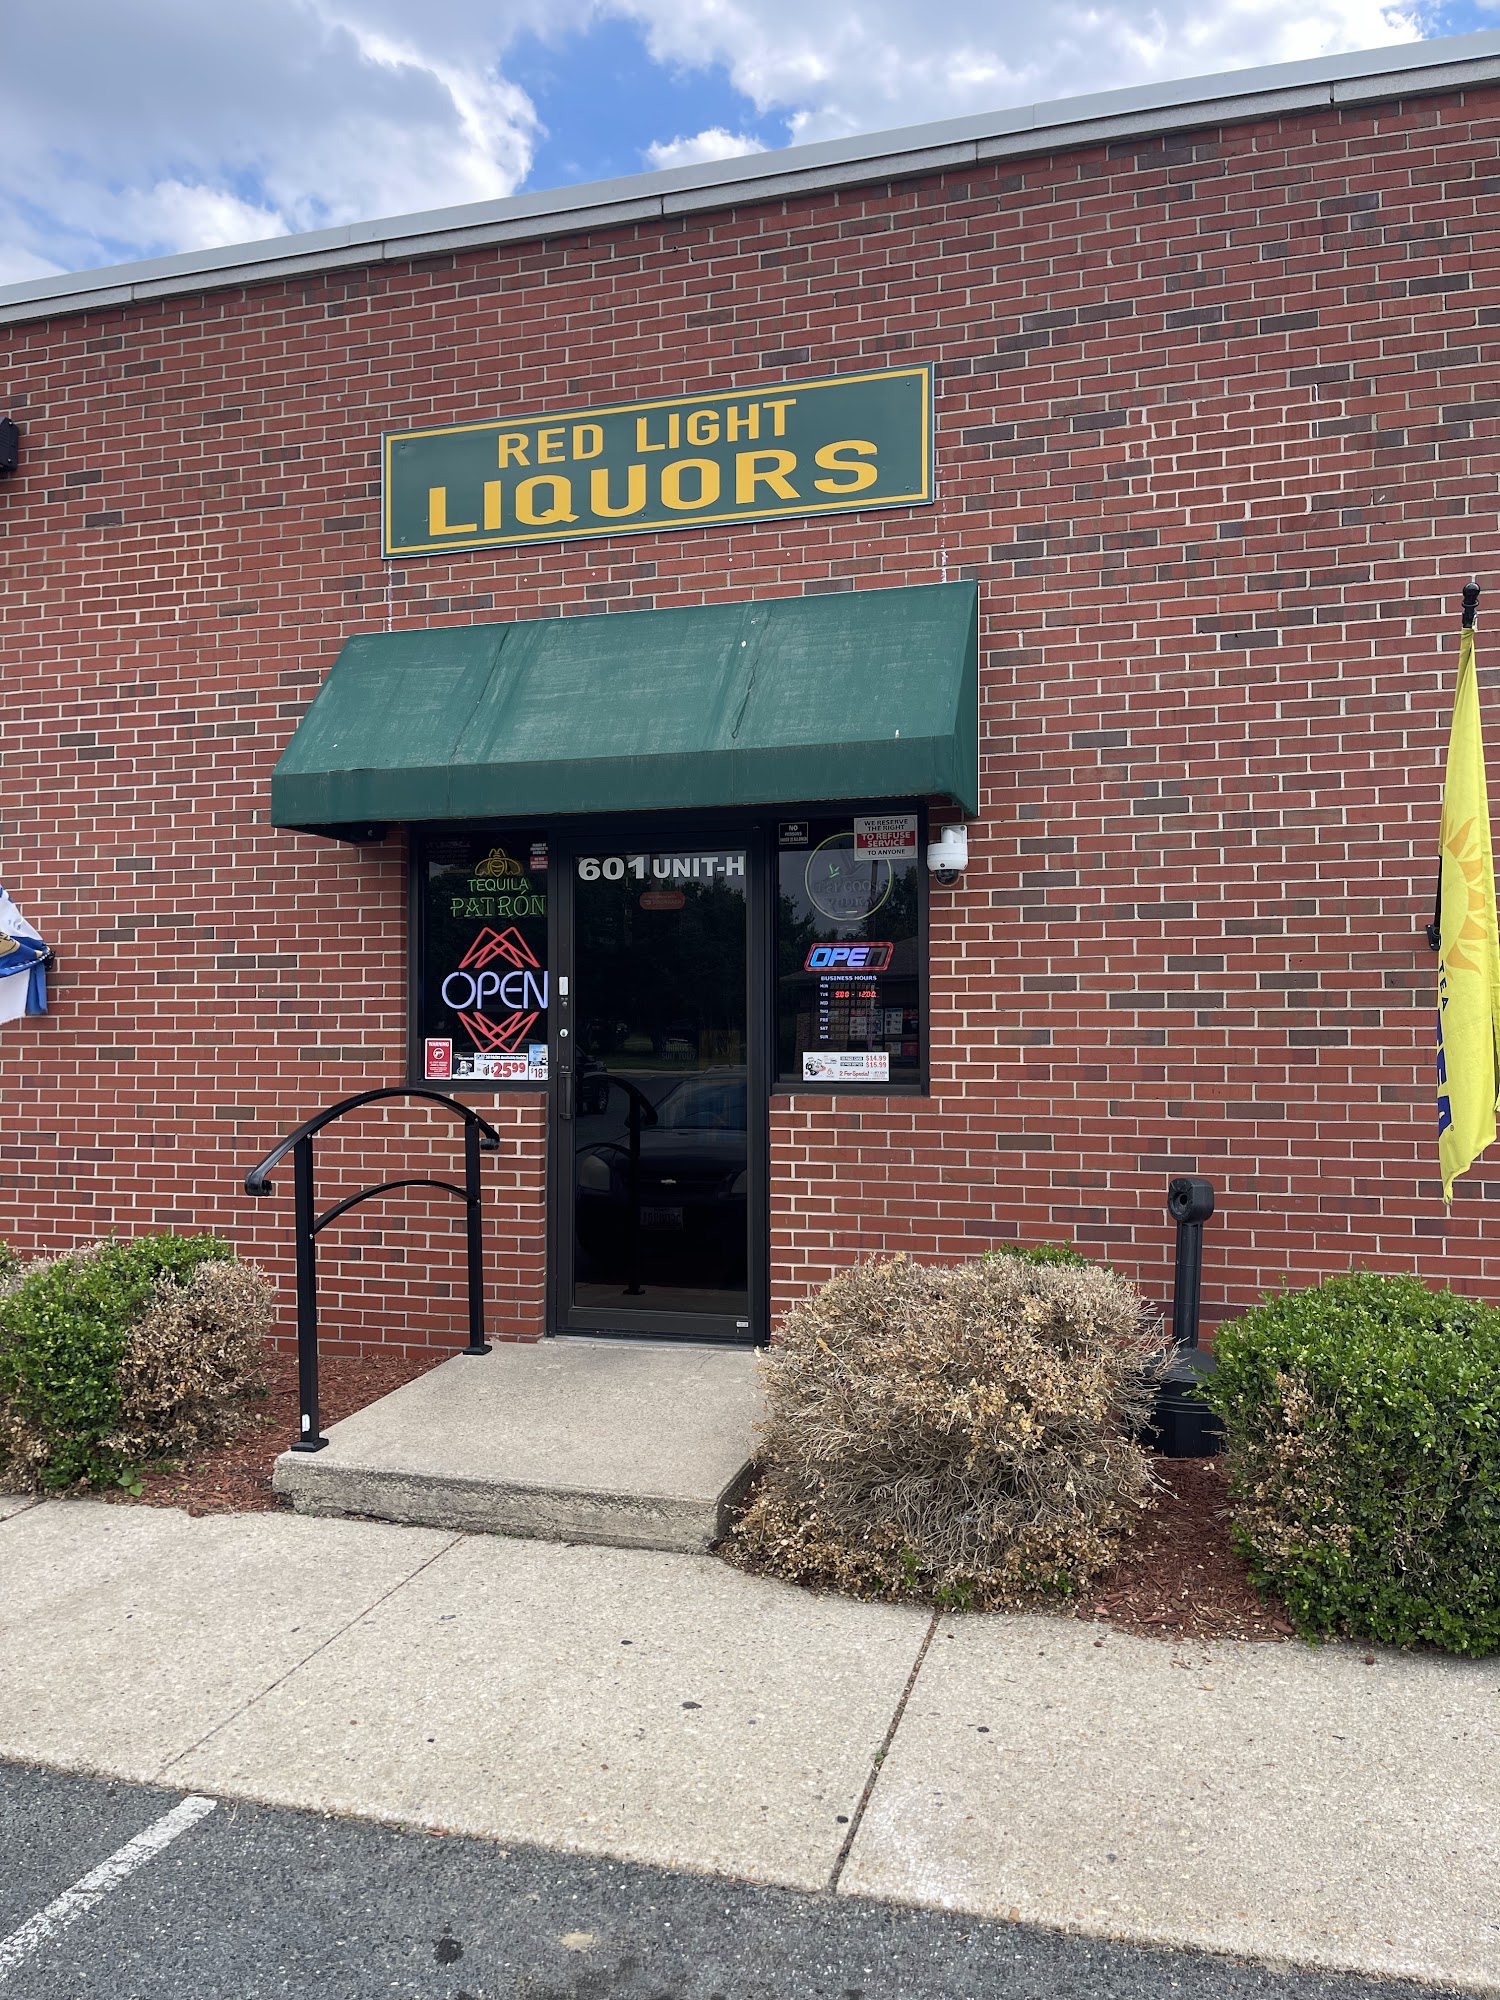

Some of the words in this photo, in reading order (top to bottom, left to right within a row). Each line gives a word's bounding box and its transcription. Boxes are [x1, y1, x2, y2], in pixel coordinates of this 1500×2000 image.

[498, 424, 603, 468] RED
[636, 398, 797, 453] LIGHT
[428, 439, 878, 536] LIQUORS
[867, 839, 905, 848] SERVICE
[876, 831, 910, 839] REFUSE
[578, 856, 644, 880] 601
[652, 856, 744, 879] UNIT-H
[467, 877, 529, 892] TEQUILA
[450, 889, 547, 917] PATRÓN
[810, 947, 887, 967] OPEN
[441, 971, 548, 1009] OPEN
